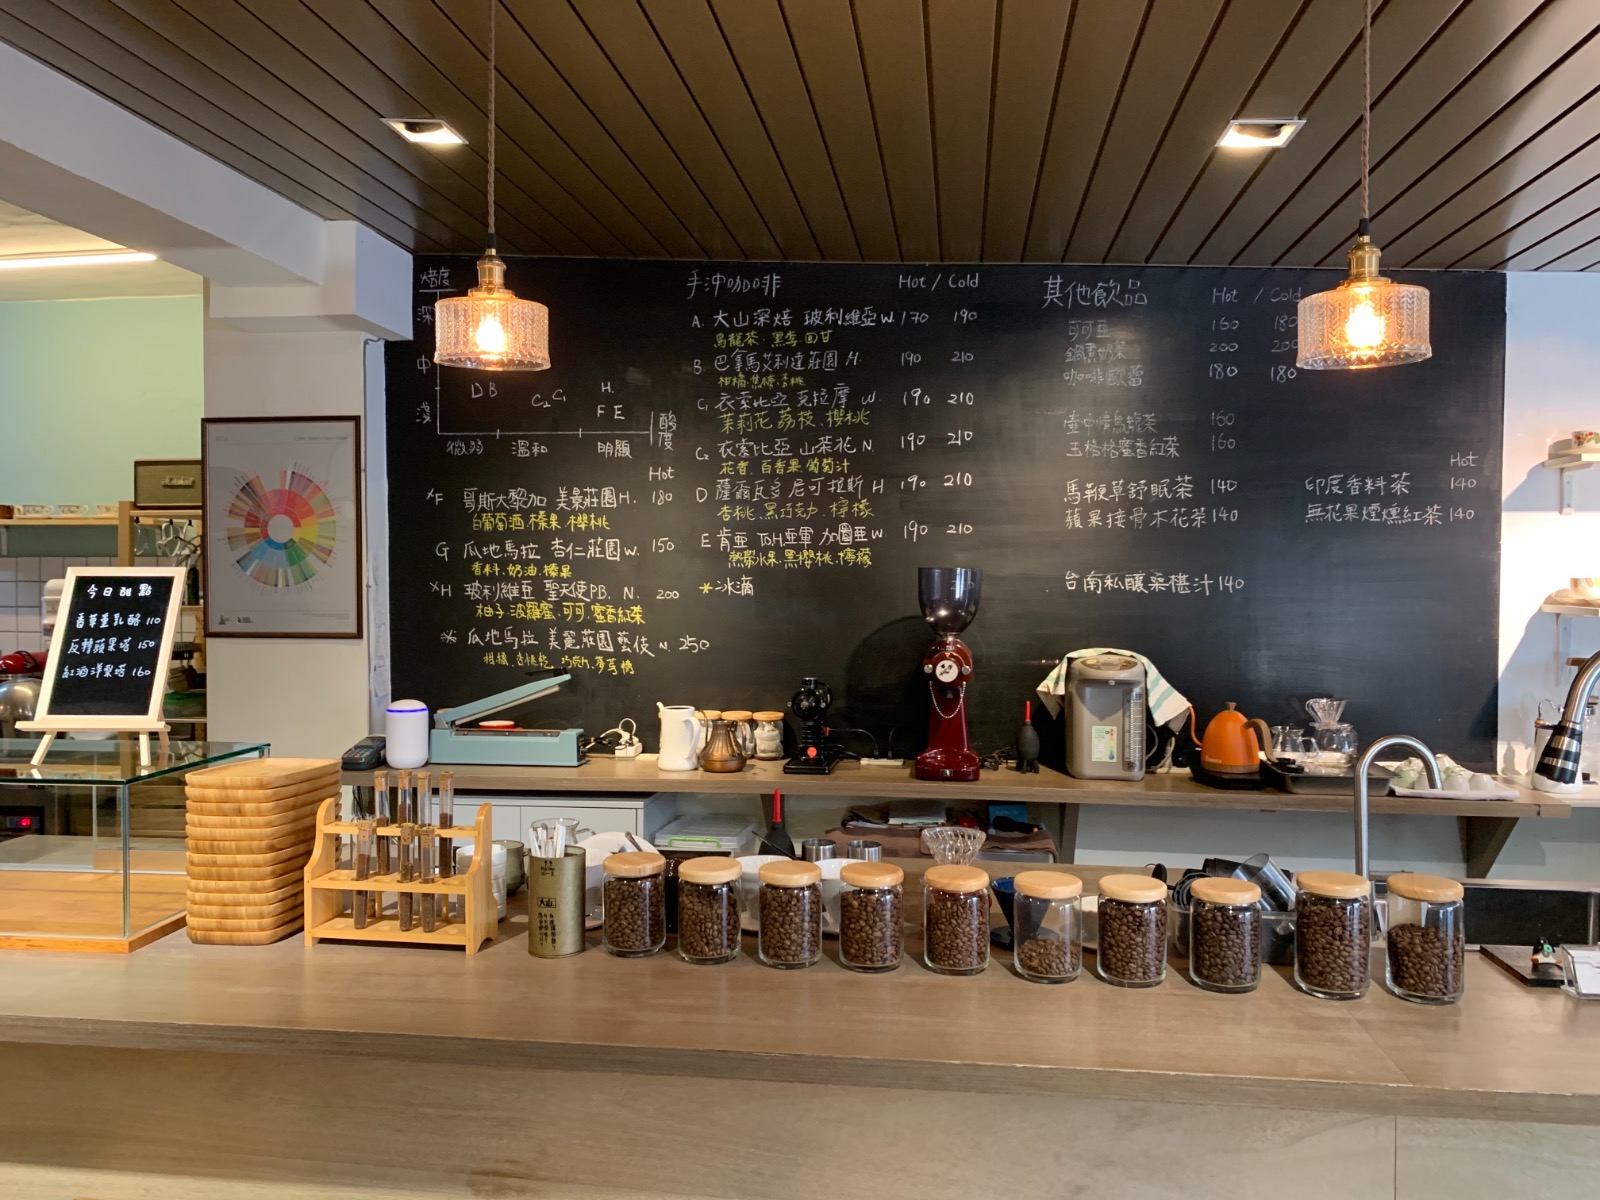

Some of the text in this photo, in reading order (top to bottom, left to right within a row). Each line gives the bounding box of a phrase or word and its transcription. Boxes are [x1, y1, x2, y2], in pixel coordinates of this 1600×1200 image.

[899, 275, 926, 290] Hot
[949, 274, 979, 289] Cold
[1042, 275, 1148, 309] 其他飲品
[1212, 287, 1239, 305] Hot
[902, 312, 929, 325] 170
[953, 311, 977, 325] 190
[1209, 342, 1239, 352] 200
[417, 355, 431, 374] 中
[901, 352, 921, 366] 190
[951, 351, 974, 363] 210
[1209, 364, 1238, 378] 180
[1270, 366, 1297, 383] 180
[903, 388, 930, 406] 190
[947, 392, 974, 405] 210
[1211, 411, 1235, 427] 160
[901, 433, 926, 451] 190
[948, 429, 973, 446] 210
[1211, 435, 1236, 452] 160
[1450, 451, 1479, 467] Hot
[649, 467, 674, 481] Hot
[901, 474, 926, 491] 190
[943, 472, 972, 487] 210
[1064, 475, 1238, 504] 馬鞭草舒眠茶 140
[1305, 472, 1477, 496] 印度香料茶 140
[653, 491, 673, 505] 180
[1064, 507, 1239, 529] 蘋果接骨木花茶 140
[1305, 502, 1475, 525] 無花果煙燻紅茶 140
[904, 520, 928, 542] 190
[946, 522, 974, 535] 210
[463, 542, 541, 560] 瓜地馬拉
[653, 538, 675, 553] 150
[1218, 576, 1245, 594] 140
[656, 589, 680, 600] 200
[146, 617, 161, 626] 110
[138, 640, 155, 649] 150
[467, 626, 539, 649] 瓜地馬拉
[679, 637, 710, 651] 250
[132, 666, 151, 677] 160
